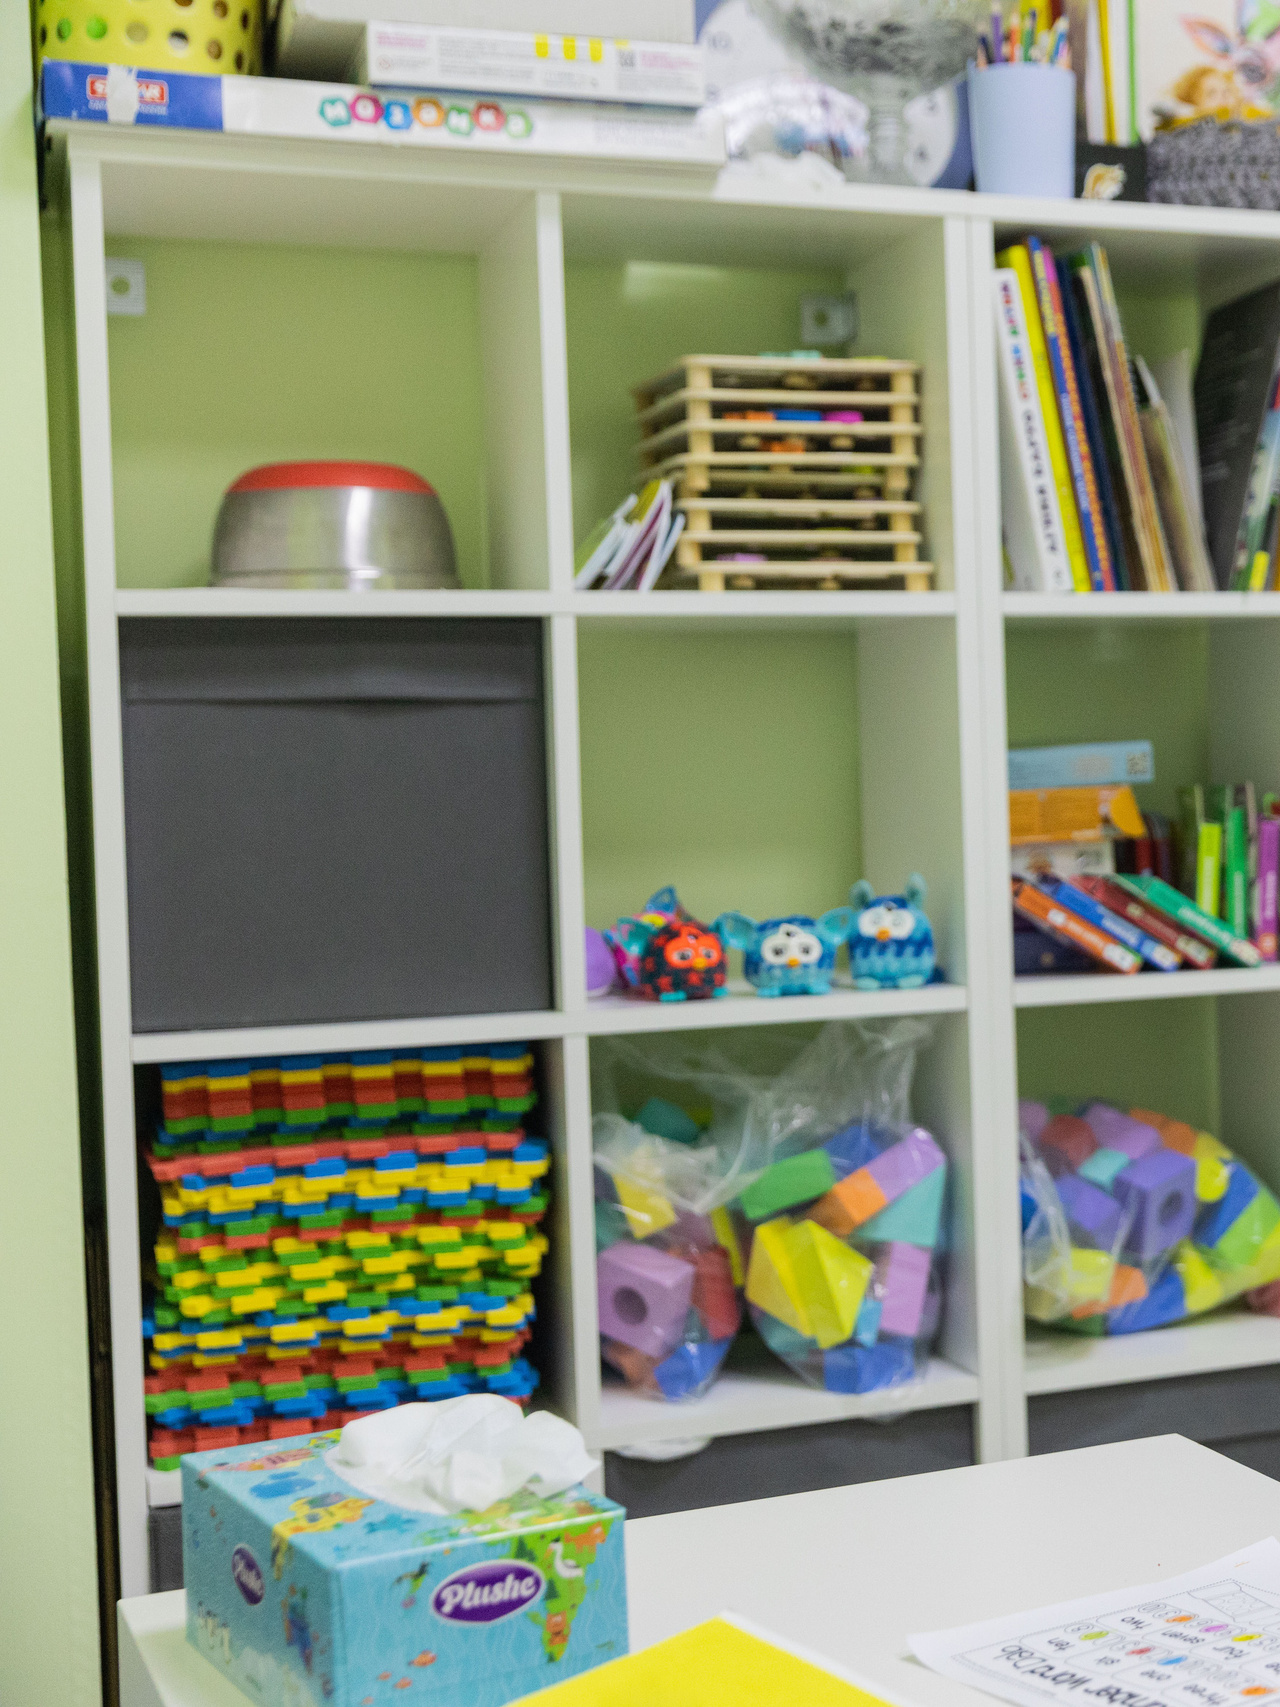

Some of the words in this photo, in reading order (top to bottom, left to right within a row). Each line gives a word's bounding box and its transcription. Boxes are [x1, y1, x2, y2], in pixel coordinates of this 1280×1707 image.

[441, 1572, 537, 1614] Plushe
[1121, 1616, 1151, 1631] two
[1047, 1637, 1076, 1652] ten
[993, 1645, 1047, 1669] Dab
[1213, 1646, 1250, 1660] four
